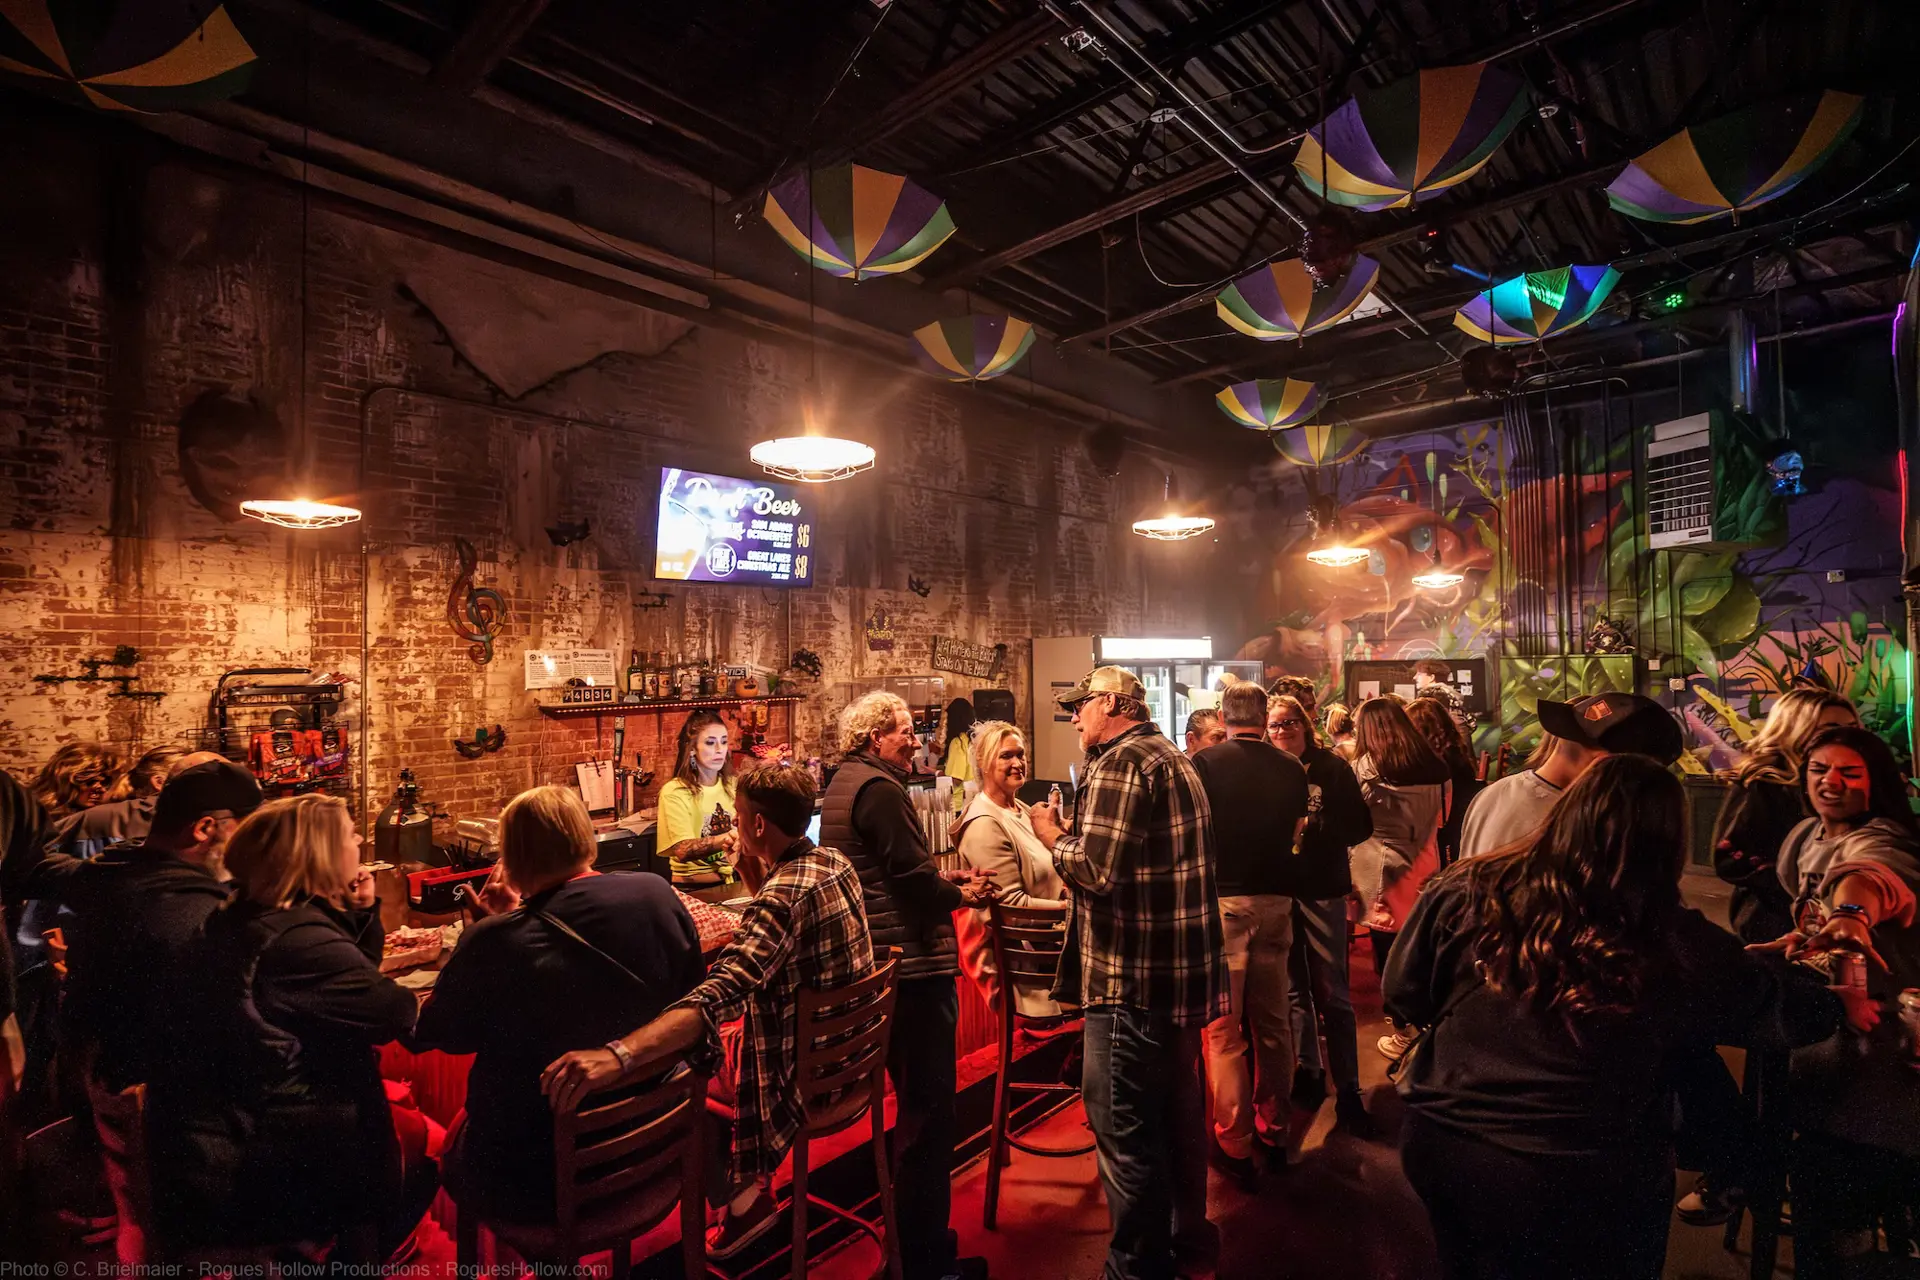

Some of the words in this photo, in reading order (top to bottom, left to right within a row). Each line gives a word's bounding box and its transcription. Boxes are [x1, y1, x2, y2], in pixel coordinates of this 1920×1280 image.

[752, 487, 801, 516] Beer
[797, 524, 810, 548] $6
[778, 562, 791, 573] ALE
[794, 555, 808, 578] $8
